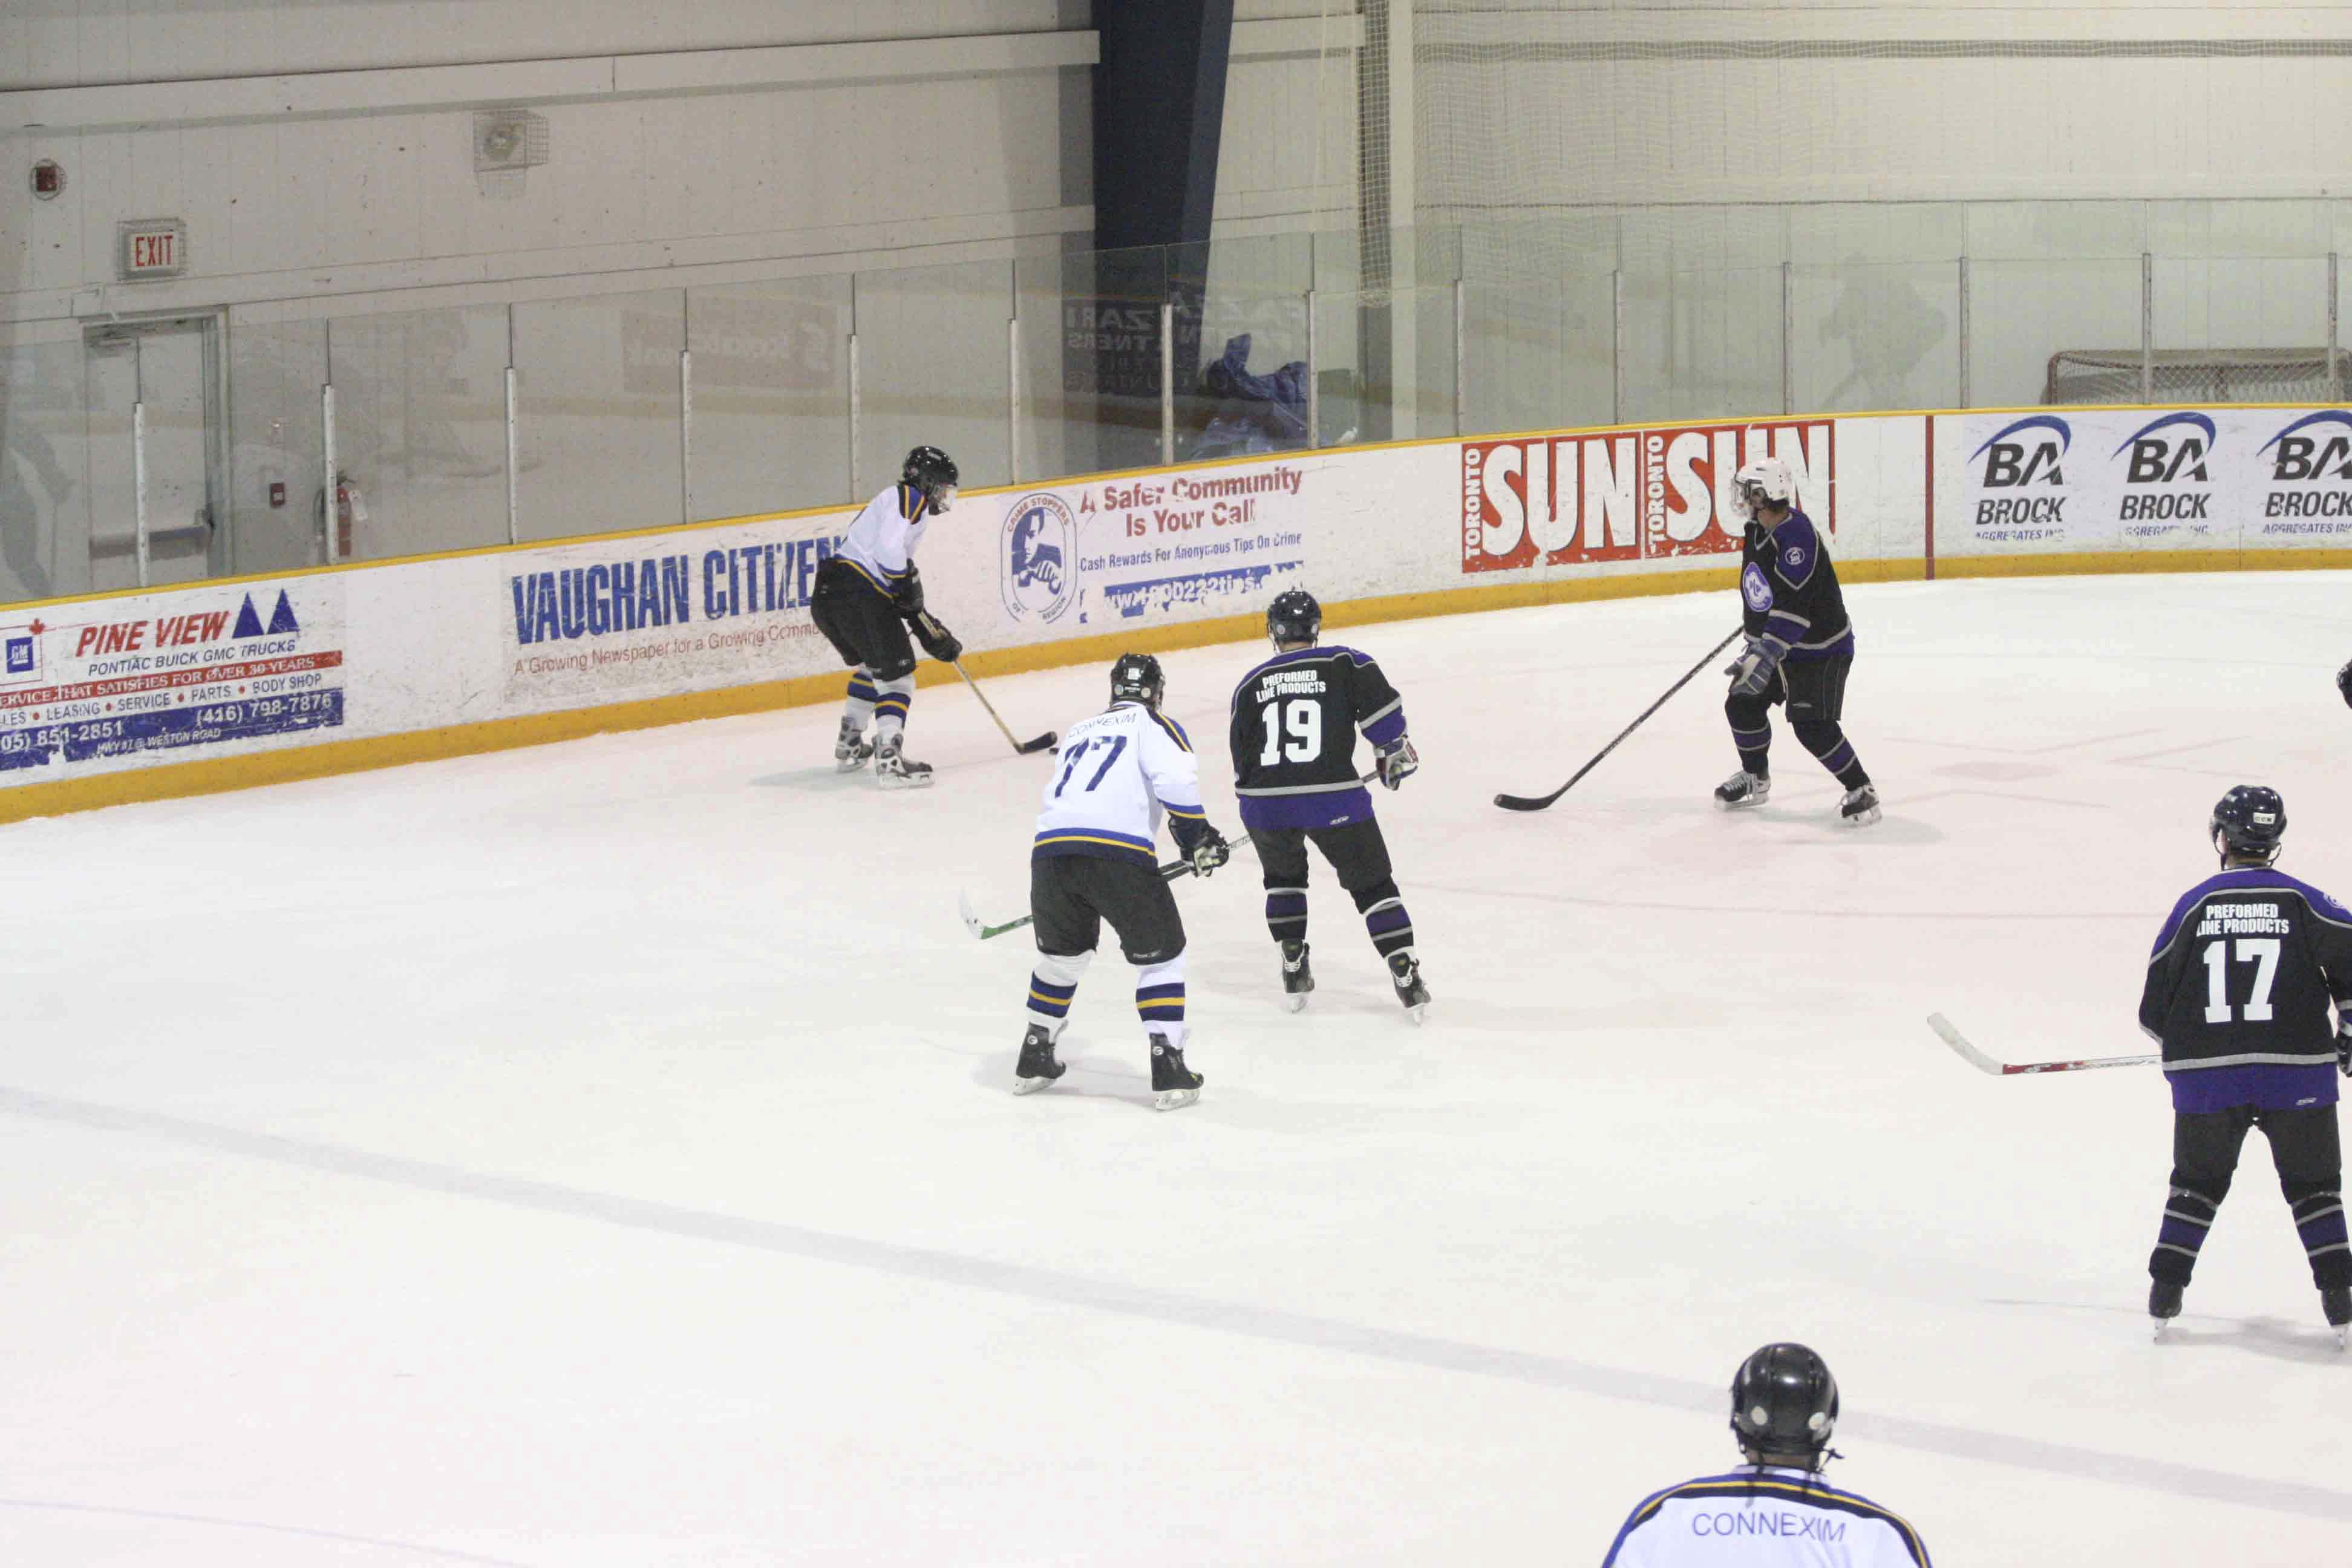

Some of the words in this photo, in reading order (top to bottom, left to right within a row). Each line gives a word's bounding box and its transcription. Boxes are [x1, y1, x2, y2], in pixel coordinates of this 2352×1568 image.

[135, 235, 174, 267] EXIT
[1982, 442, 2063, 488] BA
[2126, 437, 2208, 483] BA
[2272, 436, 2352, 480] BA
[1080, 489, 1097, 514] A
[1104, 482, 1165, 511] Safer
[1172, 466, 1302, 502] Community
[1465, 448, 1481, 561] TORONTO
[1482, 437, 1636, 556] SUN
[1647, 435, 1665, 548] TORONTO
[1666, 425, 1829, 542] SUN
[2265, 491, 2352, 518] BROCK
[1126, 513, 1146, 537] Is
[1153, 508, 1205, 533] Your
[1211, 498, 1256, 526] Call
[1976, 497, 2067, 525] BROCK
[2120, 493, 2212, 520] BROCK
[1080, 556, 1106, 572] Cash
[1109, 550, 1152, 568] Rewards
[1155, 547, 1171, 563] For
[1234, 537, 1255, 553] Tips
[1257, 535, 1270, 549] On
[1273, 532, 1301, 547] Crime
[511, 554, 690, 645] VAUGHAN
[10, 643, 30, 661] GM
[75, 620, 149, 658] PINE
[155, 610, 231, 648] VIEW
[514, 659, 524, 675] A
[529, 654, 587, 673] Growing
[592, 641, 669, 664] Newspaper
[674, 638, 691, 654] for
[696, 638, 704, 650] a
[708, 629, 765, 648] Growing
[768, 623, 822, 642] Commu
[88, 657, 151, 676] PONTIAC
[155, 652, 198, 668] BUICK
[203, 647, 235, 661] GMC
[241, 639, 296, 656] TRUCKS
[1263, 670, 1318, 688] PREFORMED
[0, 691, 51, 707] ERVICE
[56, 684, 93, 700] THAT
[96, 675, 168, 694] SATISFIES
[172, 671, 203, 686] FOR
[206, 665, 245, 681] OVER
[270, 657, 315, 672] YEARS
[0, 711, 27, 726] LES
[47, 702, 100, 720] LEASING
[117, 692, 171, 712] SERVICE
[191, 685, 232, 702] PARTS
[253, 678, 286, 694] BODY
[290, 673, 322, 690] SHOP
[1256, 687, 1276, 704] LINE
[1276, 681, 1327, 696] PRODUCTS
[0, 732, 31, 750] 05)
[37, 720, 123, 746] 851-2851
[195, 705, 243, 727] (416)
[249, 694, 332, 718] 798-7876
[147, 731, 191, 746] WESTON
[192, 728, 221, 741] ROAD
[1260, 699, 1322, 766] 19
[2196, 920, 2221, 937] LINE
[2223, 918, 2290, 934] PRODUCTS
[2206, 903, 2279, 920] PREFORMED
[2203, 938, 2281, 1024] 17
[1692, 1511, 1847, 1542] CONNEXIM
